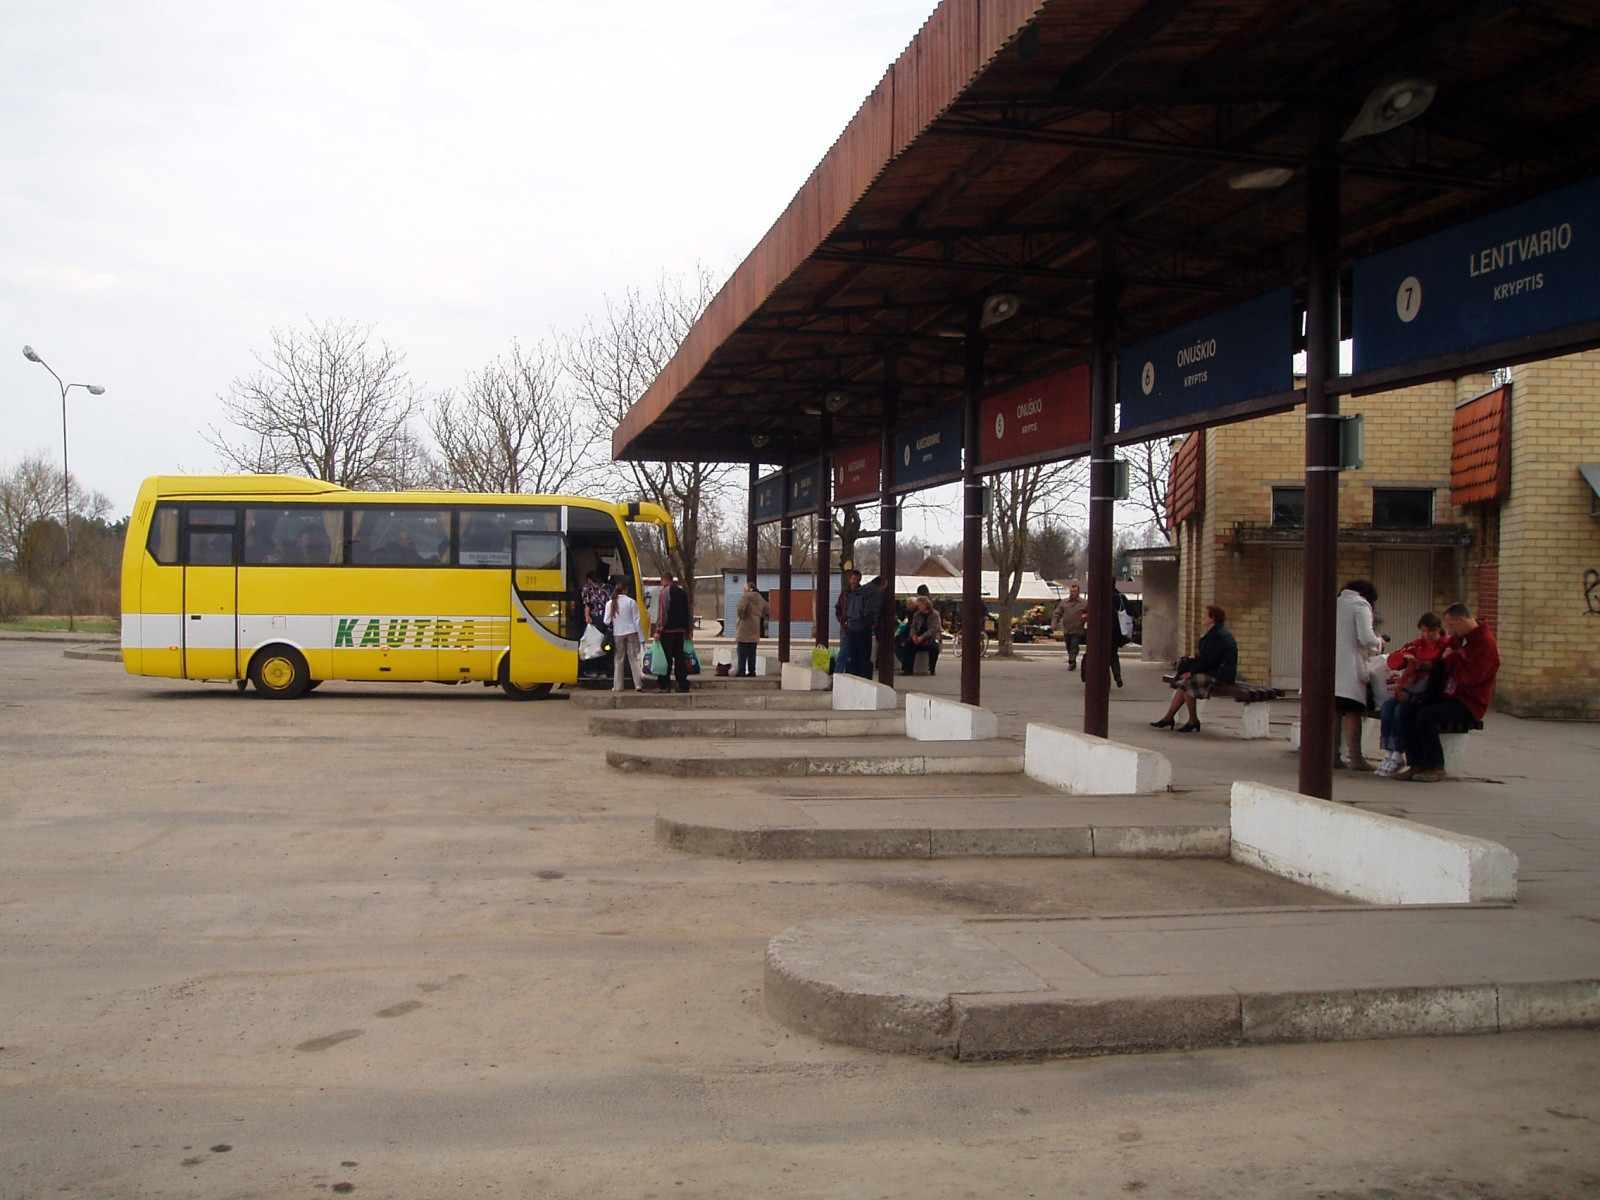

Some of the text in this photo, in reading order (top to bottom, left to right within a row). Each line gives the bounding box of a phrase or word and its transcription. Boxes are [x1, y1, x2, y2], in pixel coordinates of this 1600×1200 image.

[1469, 222, 1572, 277] LENTVARIO
[1493, 272, 1544, 300] KRYPTIS
[1183, 370, 1208, 387] KRYPTIS
[525, 575, 537, 585] 211
[334, 618, 475, 649] KAUTRA
